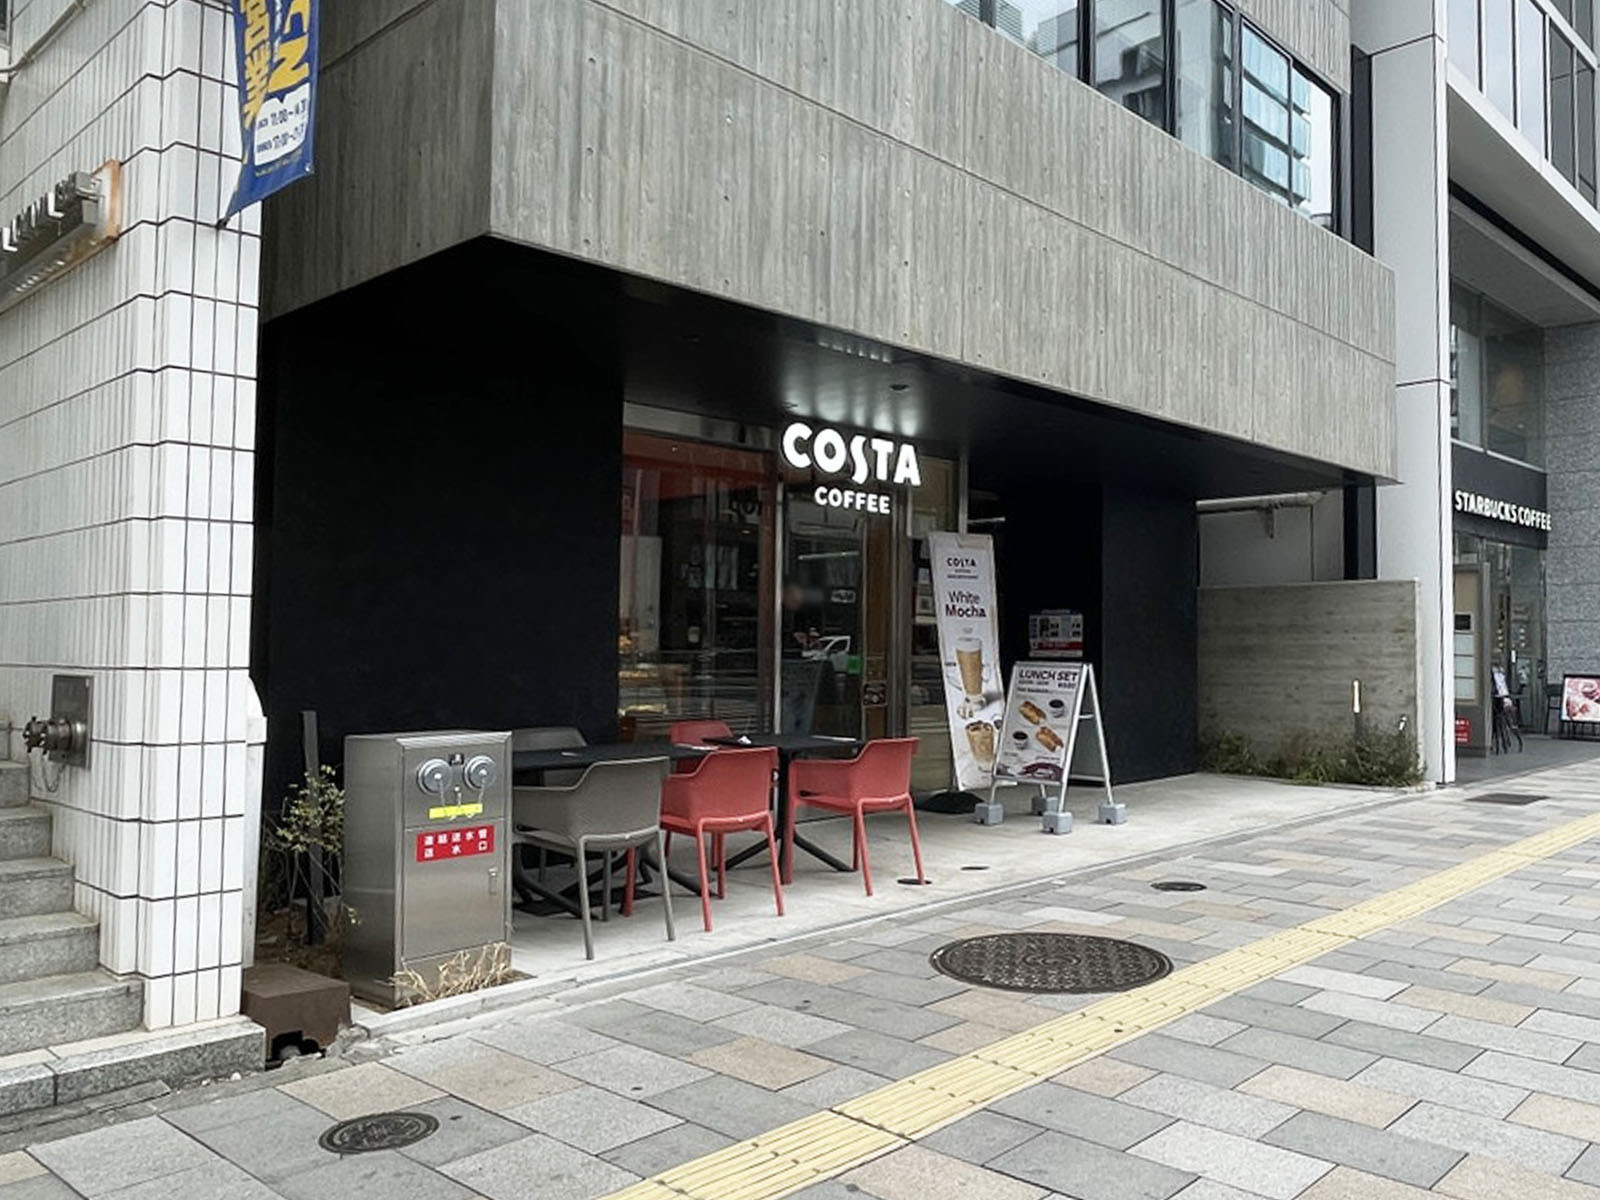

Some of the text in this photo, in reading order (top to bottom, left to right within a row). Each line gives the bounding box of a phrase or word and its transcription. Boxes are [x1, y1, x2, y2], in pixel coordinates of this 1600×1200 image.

[782, 422, 921, 486] COSTA
[814, 486, 890, 514] COFFEE
[1455, 489, 1552, 531] STARBUCKS COFFEE
[947, 557, 977, 568] COSTA
[949, 590, 981, 605] White
[945, 603, 987, 618] Mocha
[1018, 668, 1078, 682] LUNCH SET
